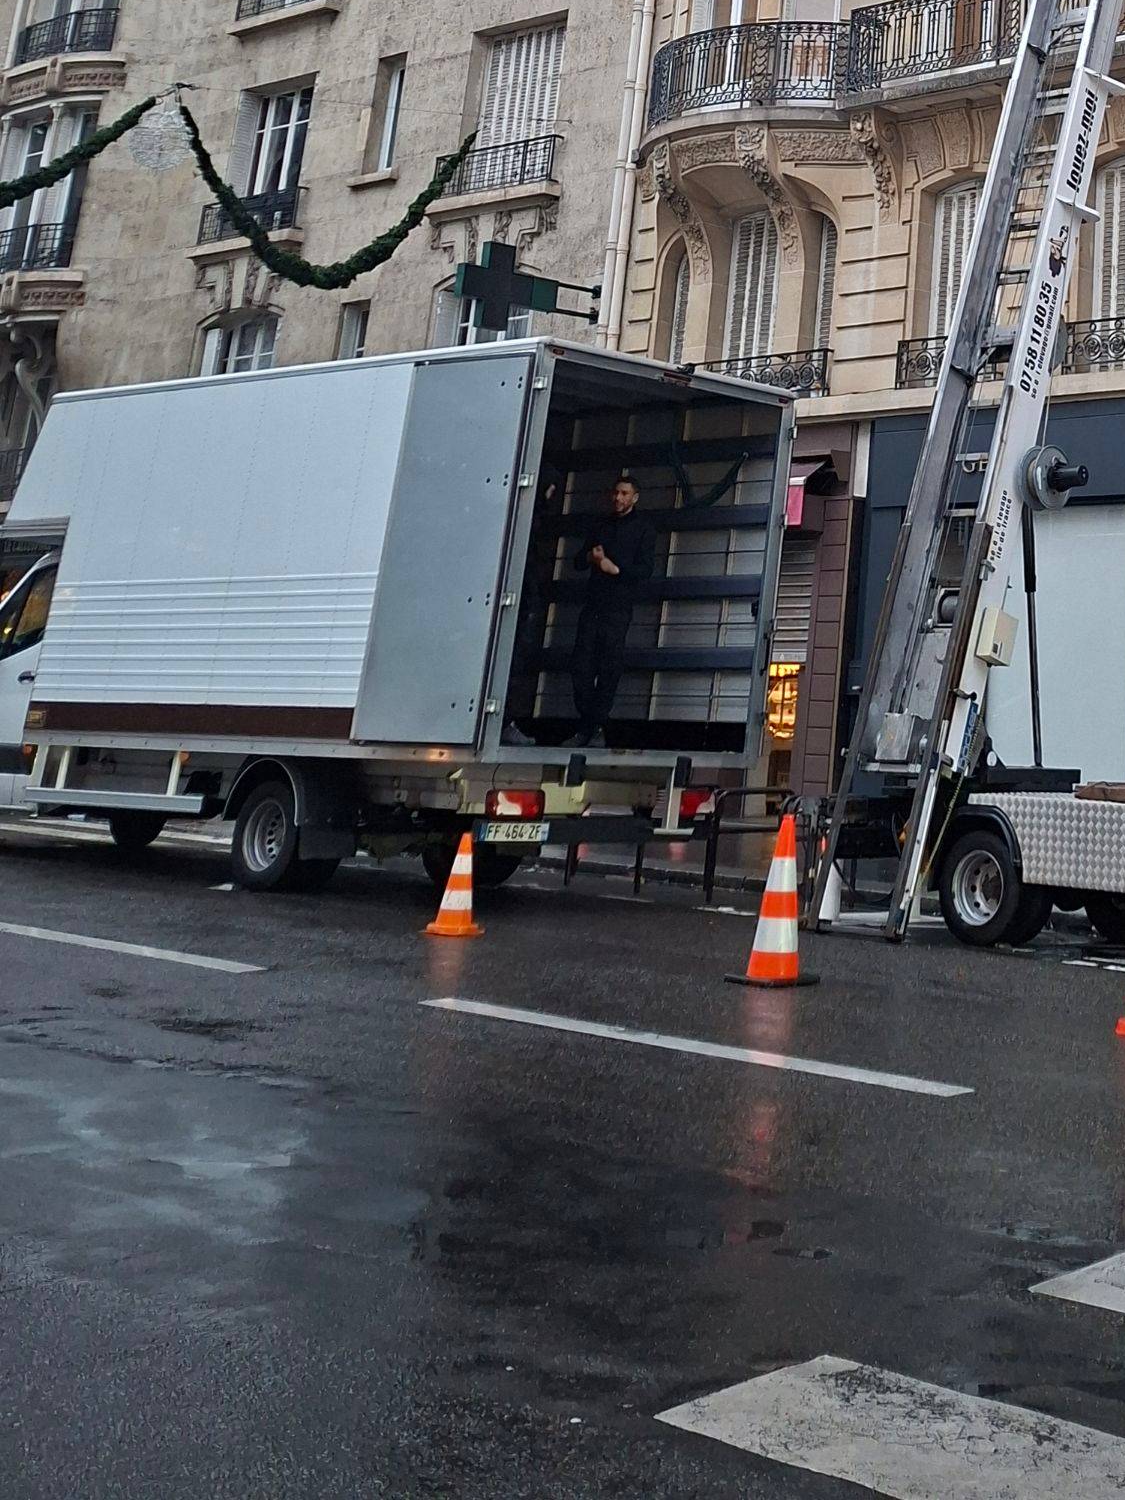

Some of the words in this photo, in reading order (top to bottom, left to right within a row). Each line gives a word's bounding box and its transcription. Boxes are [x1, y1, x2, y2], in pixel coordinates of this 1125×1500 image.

[1066, 88, 1098, 193] louez-moi
[1039, 280, 1052, 304] 35
[1034, 304, 1047, 328] 80
[1030, 327, 1042, 345] 11
[1025, 346, 1038, 371] 58
[1020, 370, 1032, 393] 07
